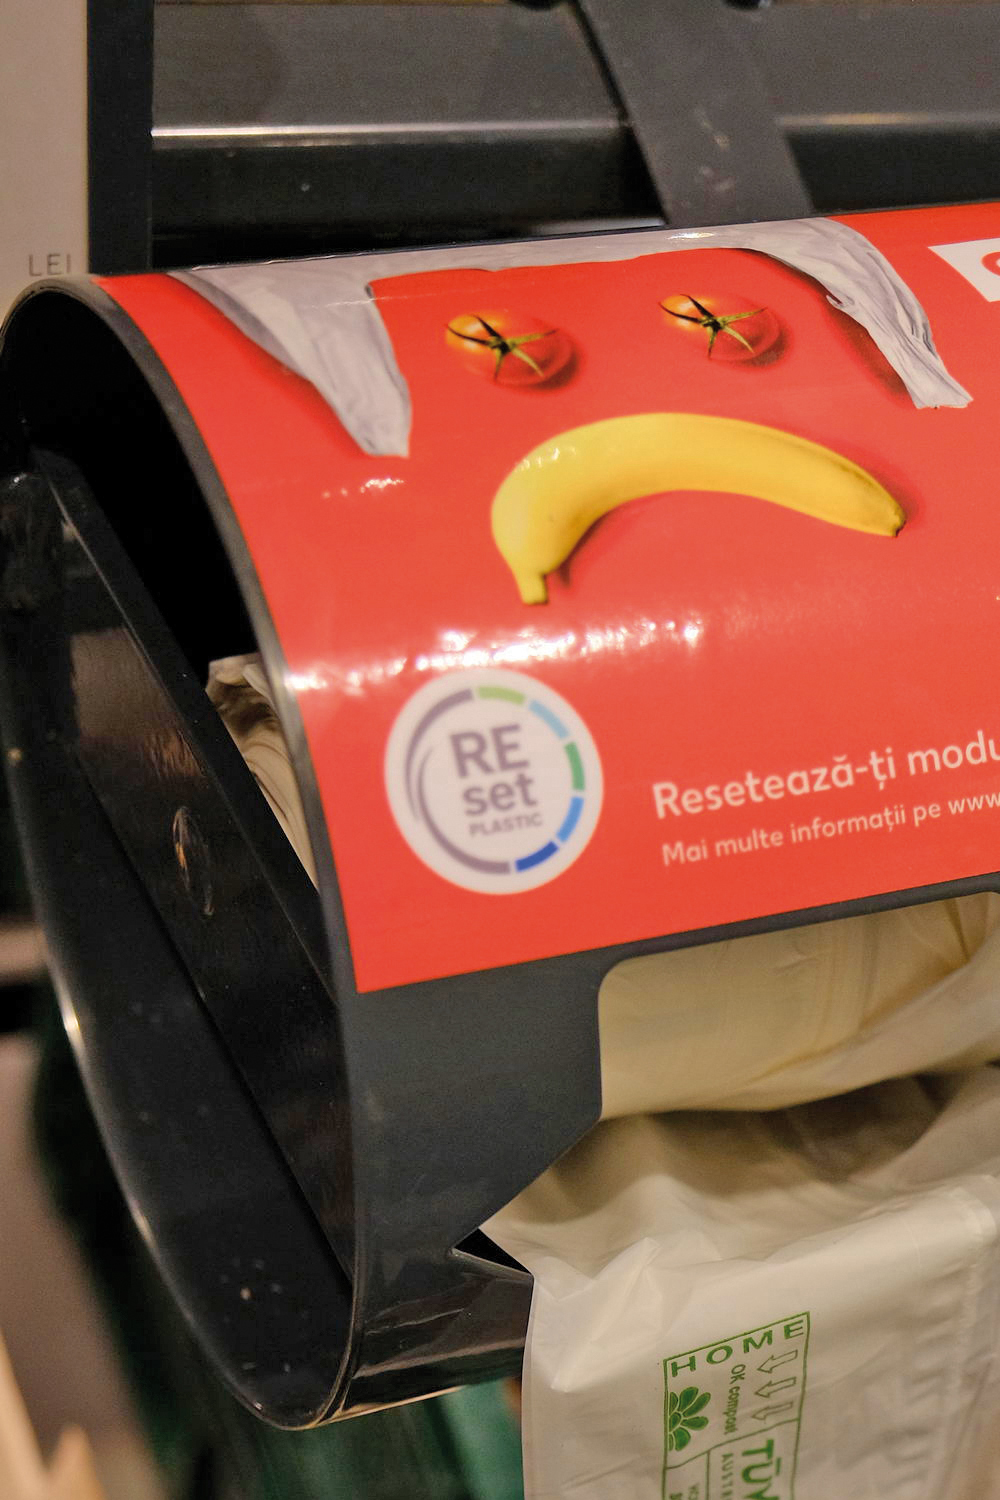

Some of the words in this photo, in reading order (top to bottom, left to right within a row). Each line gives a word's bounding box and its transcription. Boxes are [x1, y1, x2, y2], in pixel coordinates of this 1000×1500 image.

[29, 253, 71, 277] LEI
[449, 723, 530, 779] RE
[462, 773, 538, 817] set
[468, 812, 543, 837] PLASTIC
[662, 835, 709, 867] Mai
[714, 825, 784, 854] multe
[912, 799, 942, 828] pe
[670, 1319, 804, 1378] HOME
[729, 1363, 746, 1385] OK
[722, 1385, 741, 1436] compost
